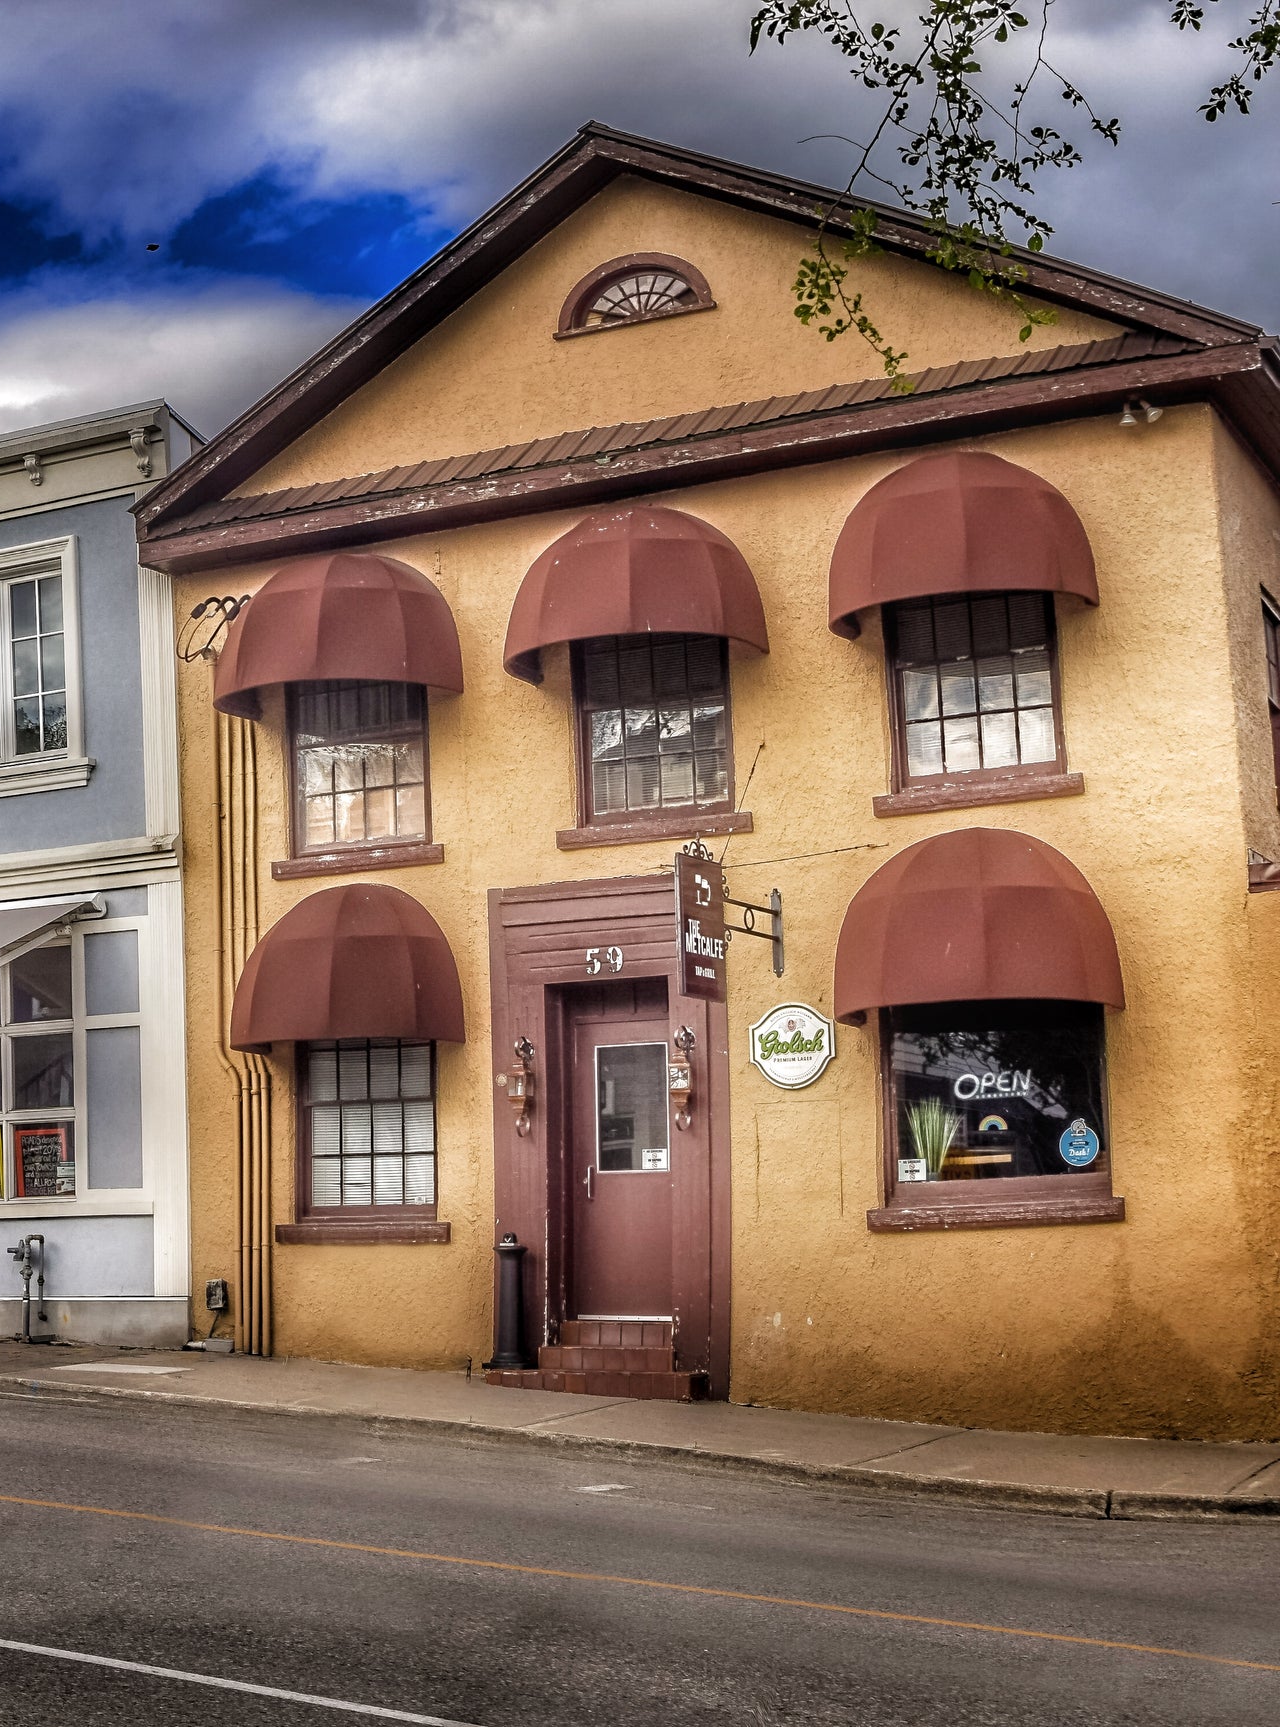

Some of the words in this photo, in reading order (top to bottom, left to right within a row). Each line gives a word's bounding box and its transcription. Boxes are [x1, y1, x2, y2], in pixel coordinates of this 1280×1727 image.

[688, 918, 702, 939] THE
[585, 946, 624, 975] 59
[685, 932, 724, 960] METCALFE
[758, 1028, 825, 1060] Grolsch
[954, 1069, 1031, 1099] OPEN
